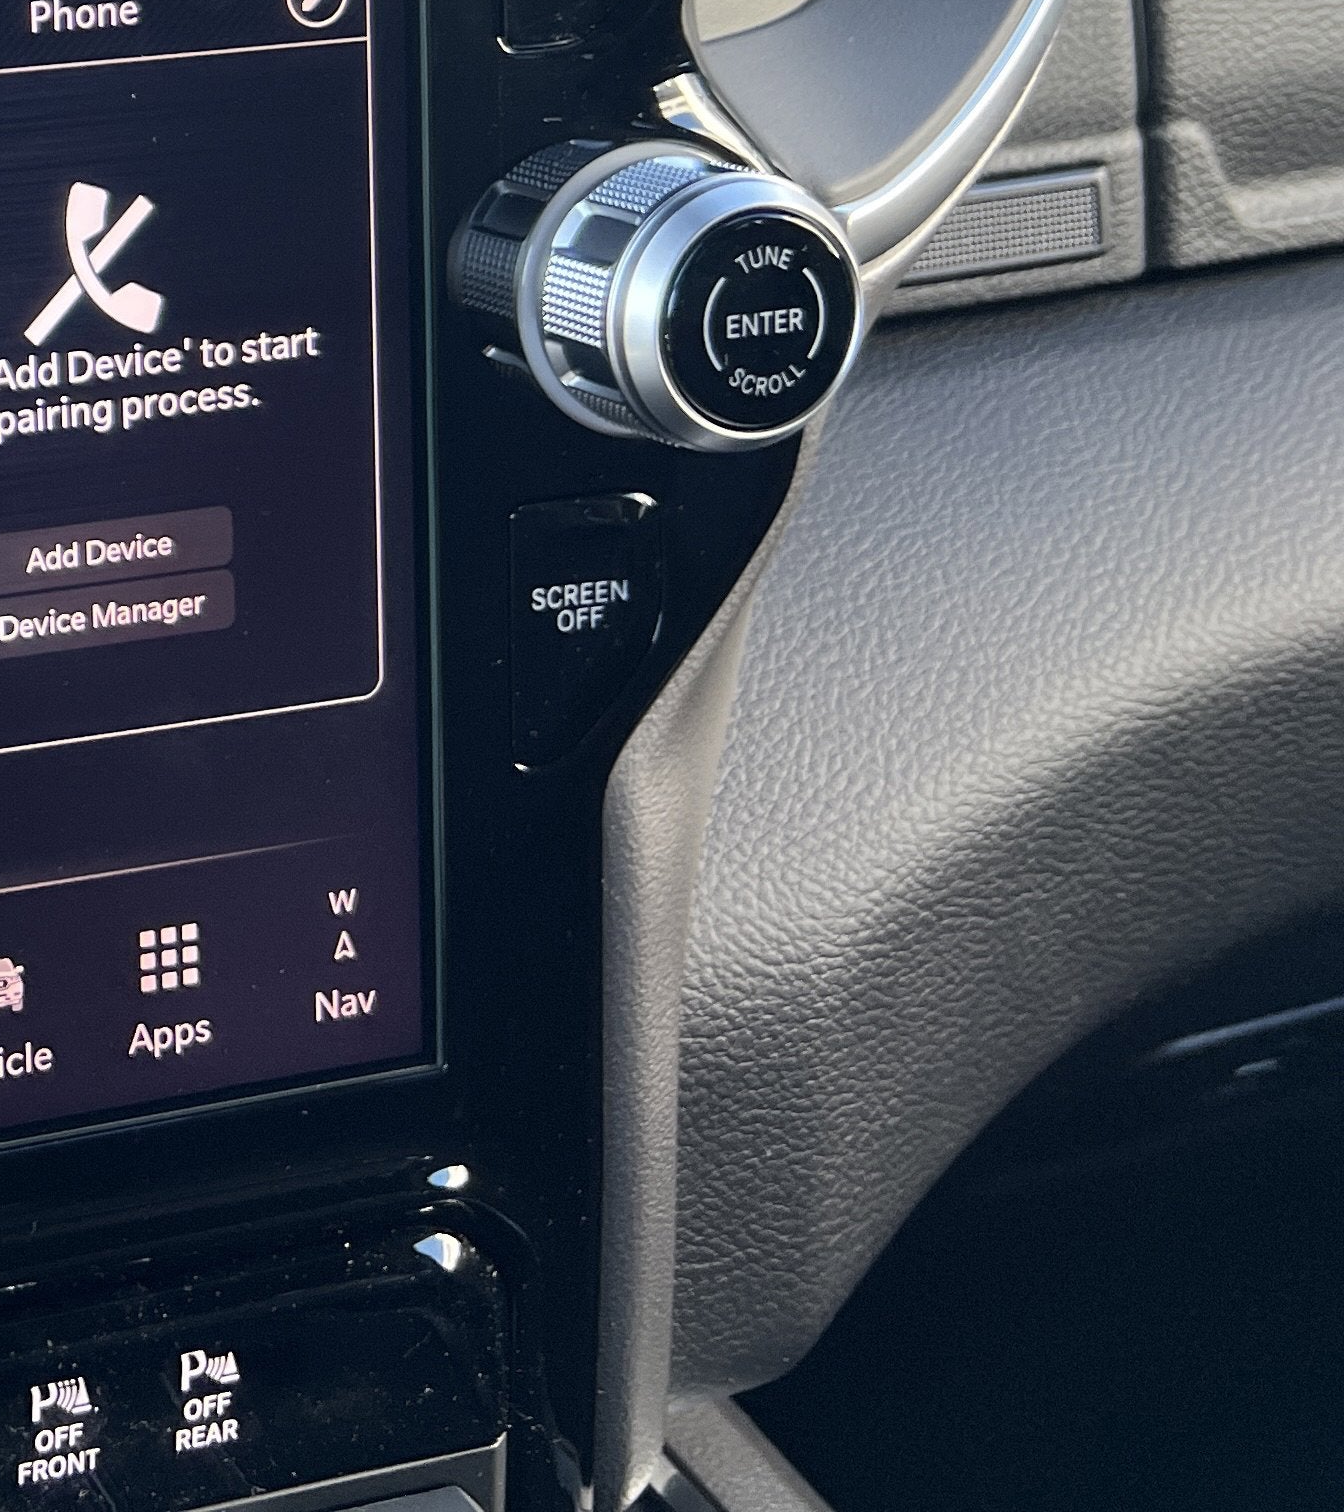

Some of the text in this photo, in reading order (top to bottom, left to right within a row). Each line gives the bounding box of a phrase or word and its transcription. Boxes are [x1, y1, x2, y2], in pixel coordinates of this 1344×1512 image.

[735, 245, 792, 275] TUNE
[726, 310, 804, 340] ENTER
[67, 340, 192, 384] Device'
[200, 336, 234, 368] to
[241, 326, 320, 365] start
[728, 364, 807, 397] SCROLL
[121, 379, 262, 429] process.
[25, 531, 174, 577] Add Device
[91, 592, 206, 630] Manager
[532, 580, 629, 612] SCREEN
[556, 606, 604, 633] OFF
[328, 888, 357, 914] W
[314, 989, 376, 1022] Nav
[128, 1016, 212, 1058] Apps
[183, 1391, 233, 1422] OFF
[34, 1422, 84, 1453] OFF
[176, 1419, 238, 1453] REAR
[18, 1447, 101, 1486] FRONT
